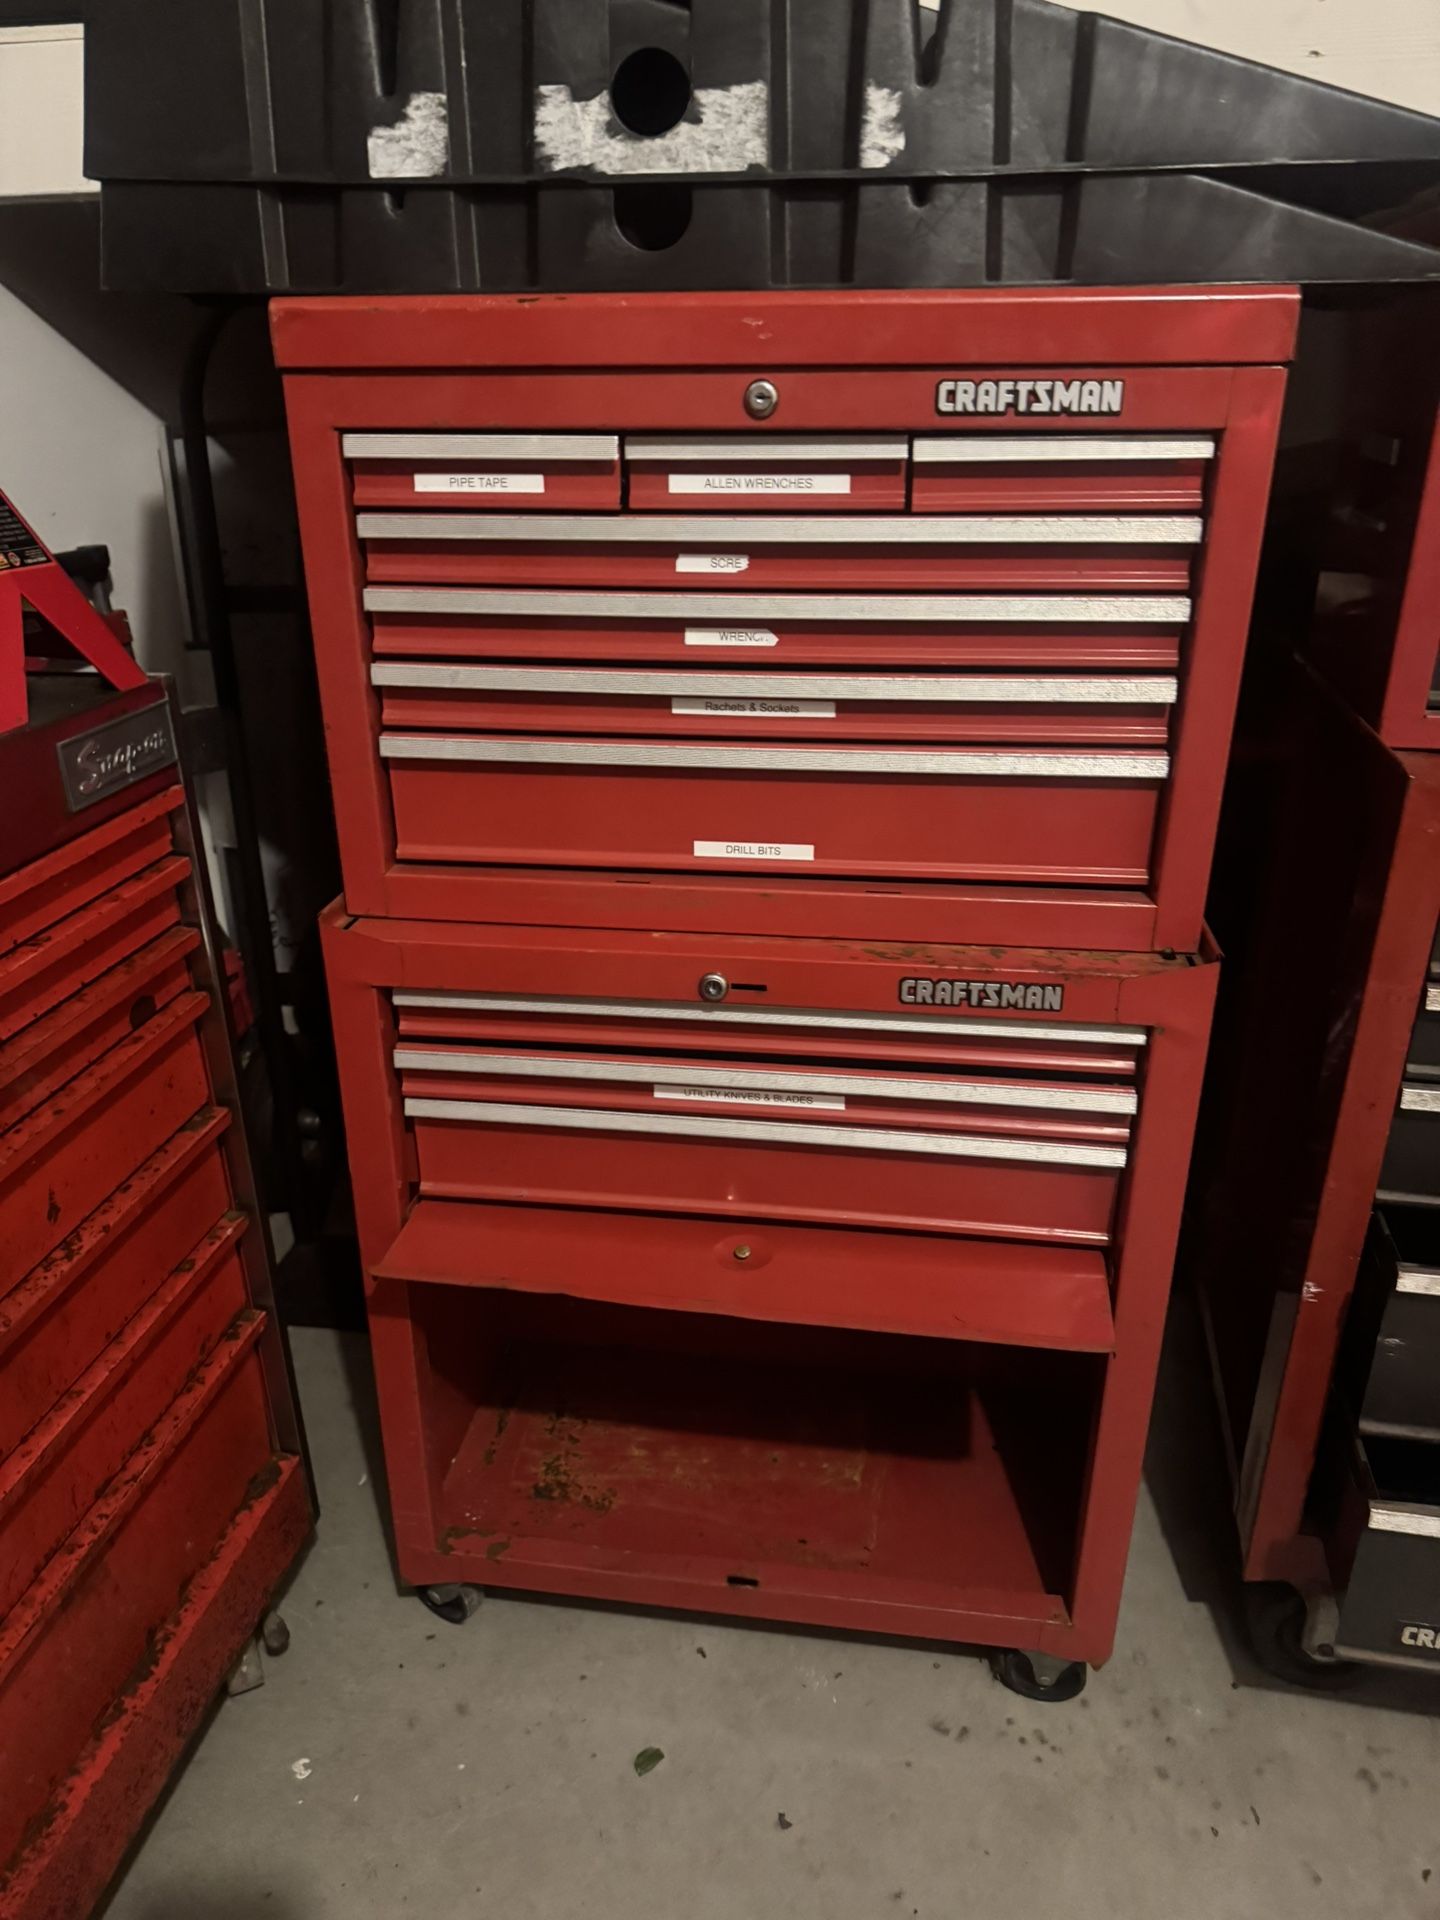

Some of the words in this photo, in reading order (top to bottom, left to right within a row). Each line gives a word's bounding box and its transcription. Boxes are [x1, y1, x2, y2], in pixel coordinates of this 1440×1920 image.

[936, 380, 1124, 414] CRAFTSMAN
[449, 477, 476, 488] PIPE
[478, 477, 508, 488] TAPE
[704, 478, 741, 489] ALLEN
[744, 478, 813, 489] WRENCHES
[710, 557, 742, 569] SCRE
[705, 701, 746, 712] Rachets
[750, 703, 757, 711] &
[759, 703, 800, 713] Sockets
[725, 845, 755, 855] DRILL
[758, 846, 781, 856] BITS
[900, 978, 1063, 1011] CRAFTSMAN
[684, 1088, 721, 1098] UTILITY
[724, 1091, 761, 1101] KNIVES
[763, 1093, 770, 1102] &
[773, 1094, 814, 1105] BLADES
